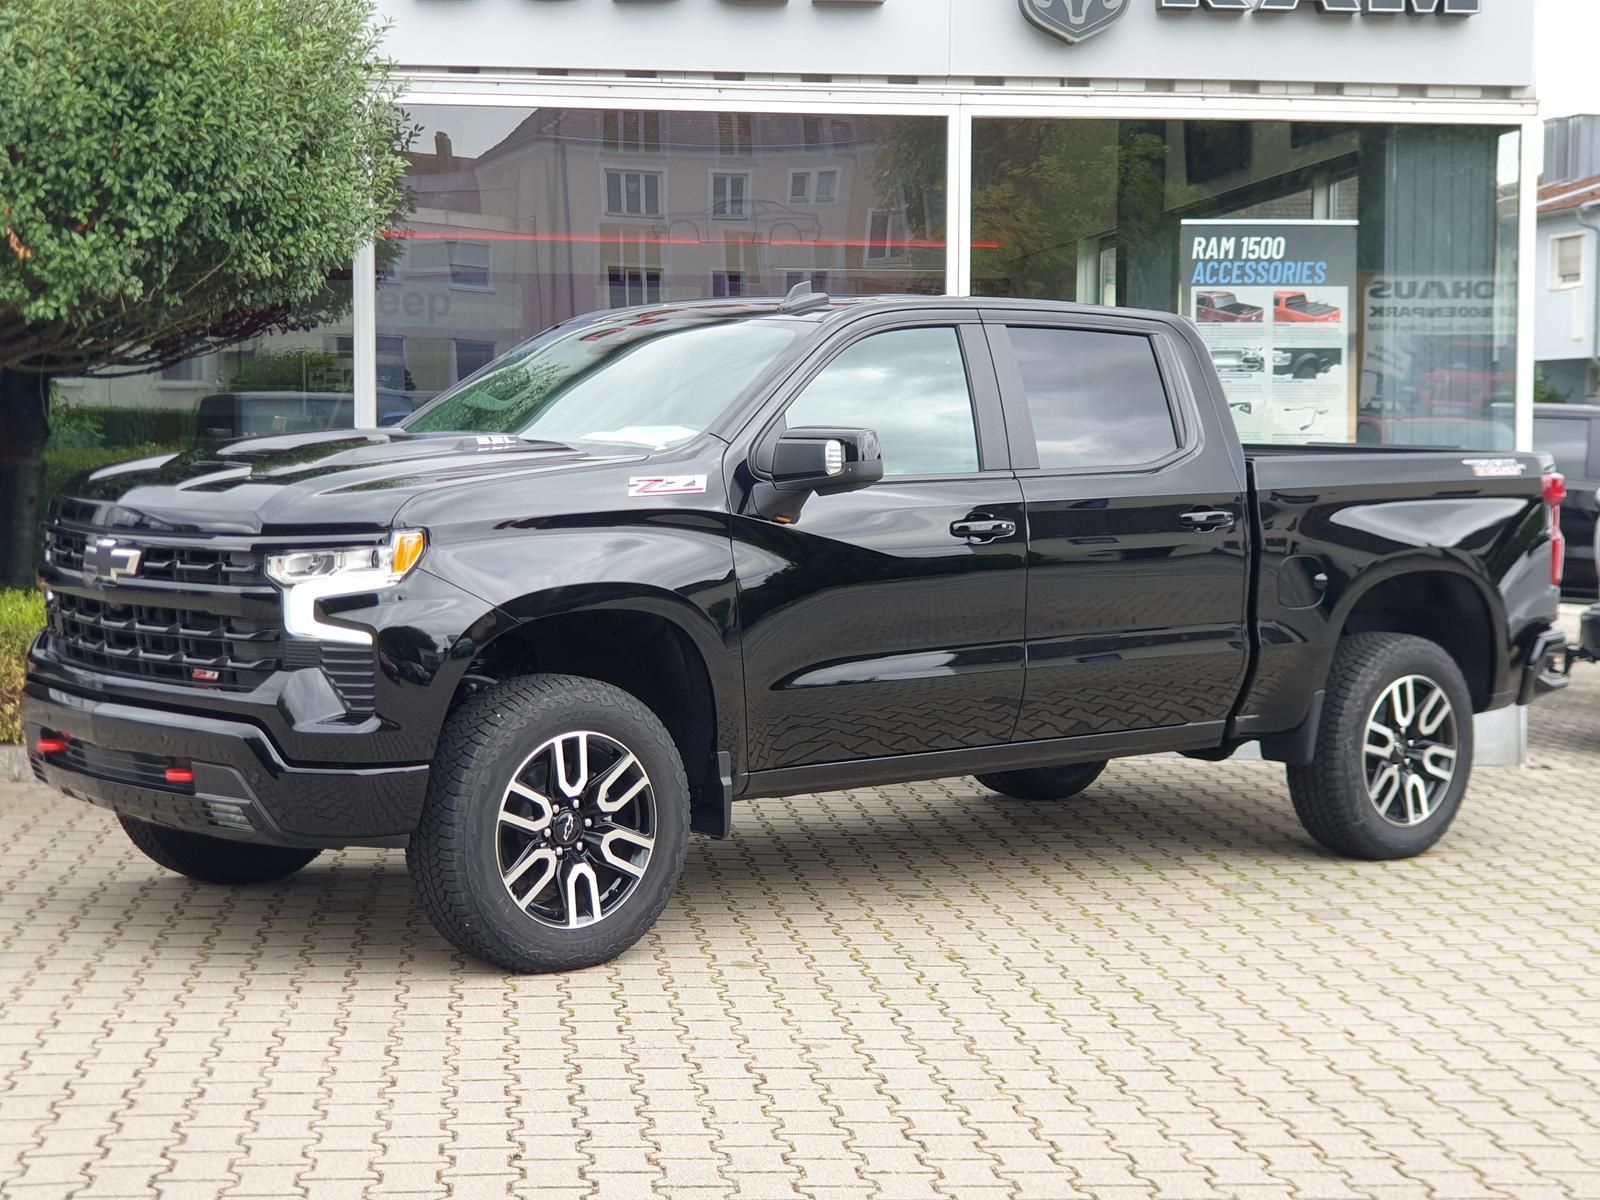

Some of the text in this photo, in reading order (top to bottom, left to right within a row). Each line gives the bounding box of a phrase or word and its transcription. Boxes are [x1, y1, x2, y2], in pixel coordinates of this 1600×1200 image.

[1191, 236, 1286, 260] RAM 1500
[1191, 260, 1328, 284] ACCESSORIES
